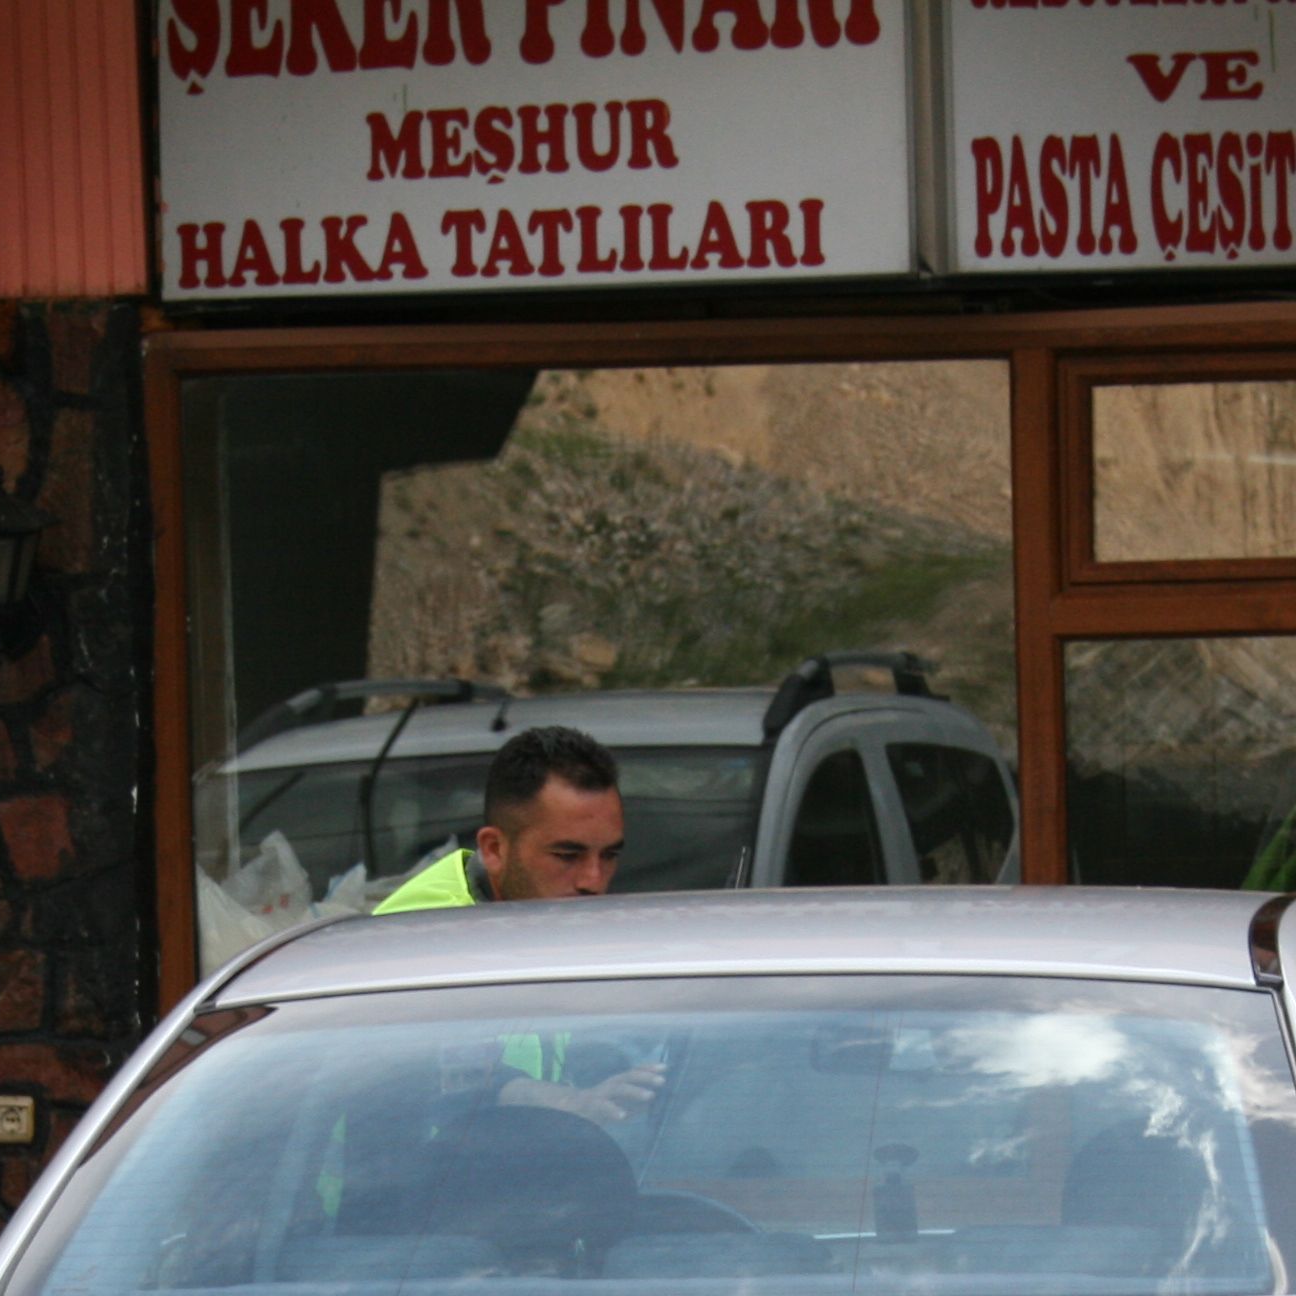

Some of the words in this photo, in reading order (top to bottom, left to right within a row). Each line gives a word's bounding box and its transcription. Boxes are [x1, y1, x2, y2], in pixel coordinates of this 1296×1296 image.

[1127, 51, 1264, 102] VE
[366, 99, 679, 184] MEŞHUR
[971, 134, 1138, 258] PASTA
[177, 212, 429, 289] HALKA
[441, 198, 826, 277] TATLILARI
